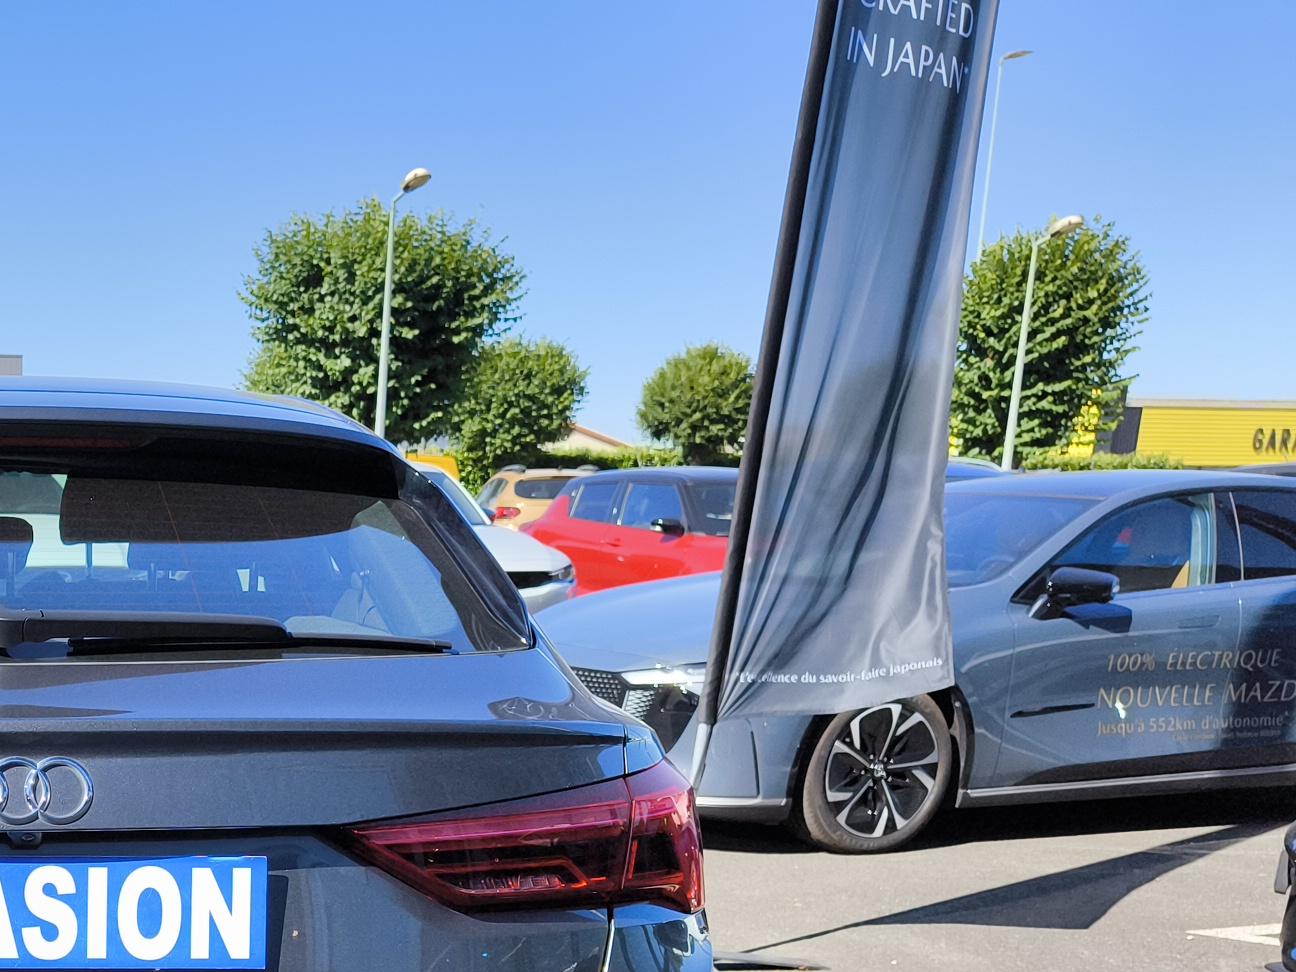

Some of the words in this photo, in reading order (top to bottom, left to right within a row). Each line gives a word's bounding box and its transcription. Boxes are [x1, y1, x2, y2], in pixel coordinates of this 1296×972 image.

[846, 26, 878, 68] IN
[800, 671, 817, 684] du
[889, 656, 944, 677] japonais
[1108, 653, 1155, 673] 100%
[1167, 648, 1281, 672] ÉLECTRIQUE
[1098, 683, 1217, 710] NOUVELLE
[1149, 716, 1196, 733] 552km
